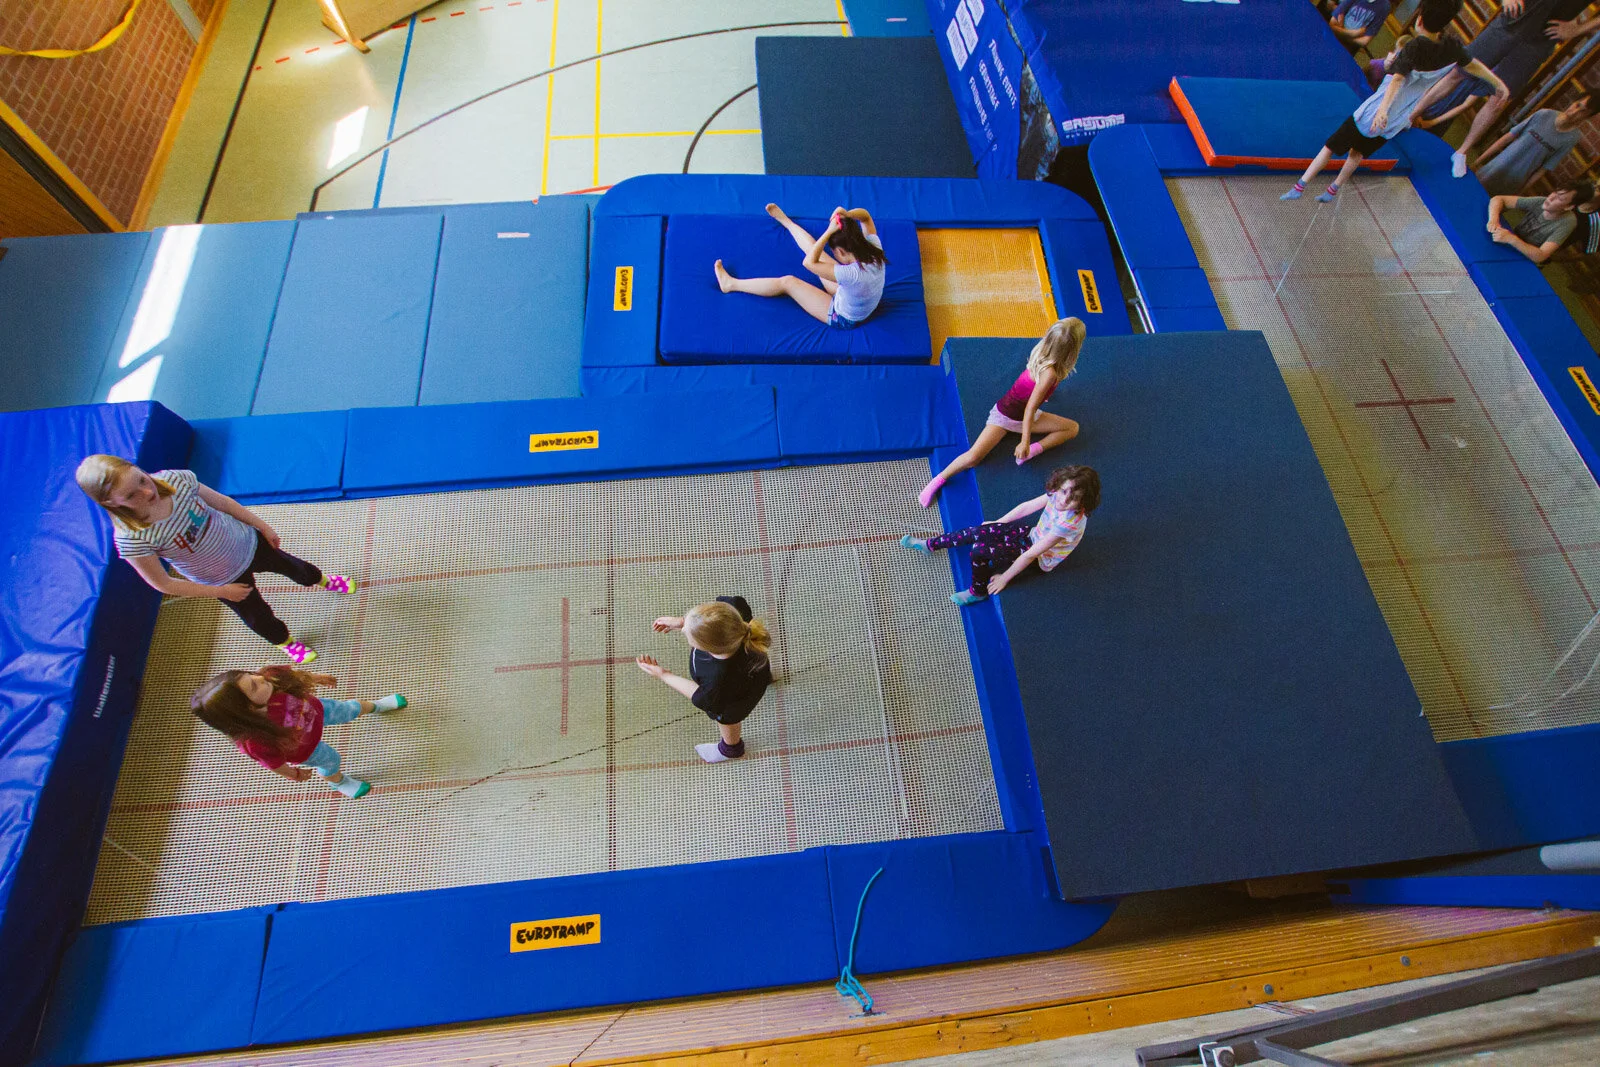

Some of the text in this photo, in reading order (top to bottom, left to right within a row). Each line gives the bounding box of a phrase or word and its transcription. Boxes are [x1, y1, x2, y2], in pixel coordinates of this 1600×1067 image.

[620, 269, 629, 307] EUROTRAMP
[534, 435, 595, 449] EUROTRAMP
[516, 921, 595, 944] EUROTRAMP
